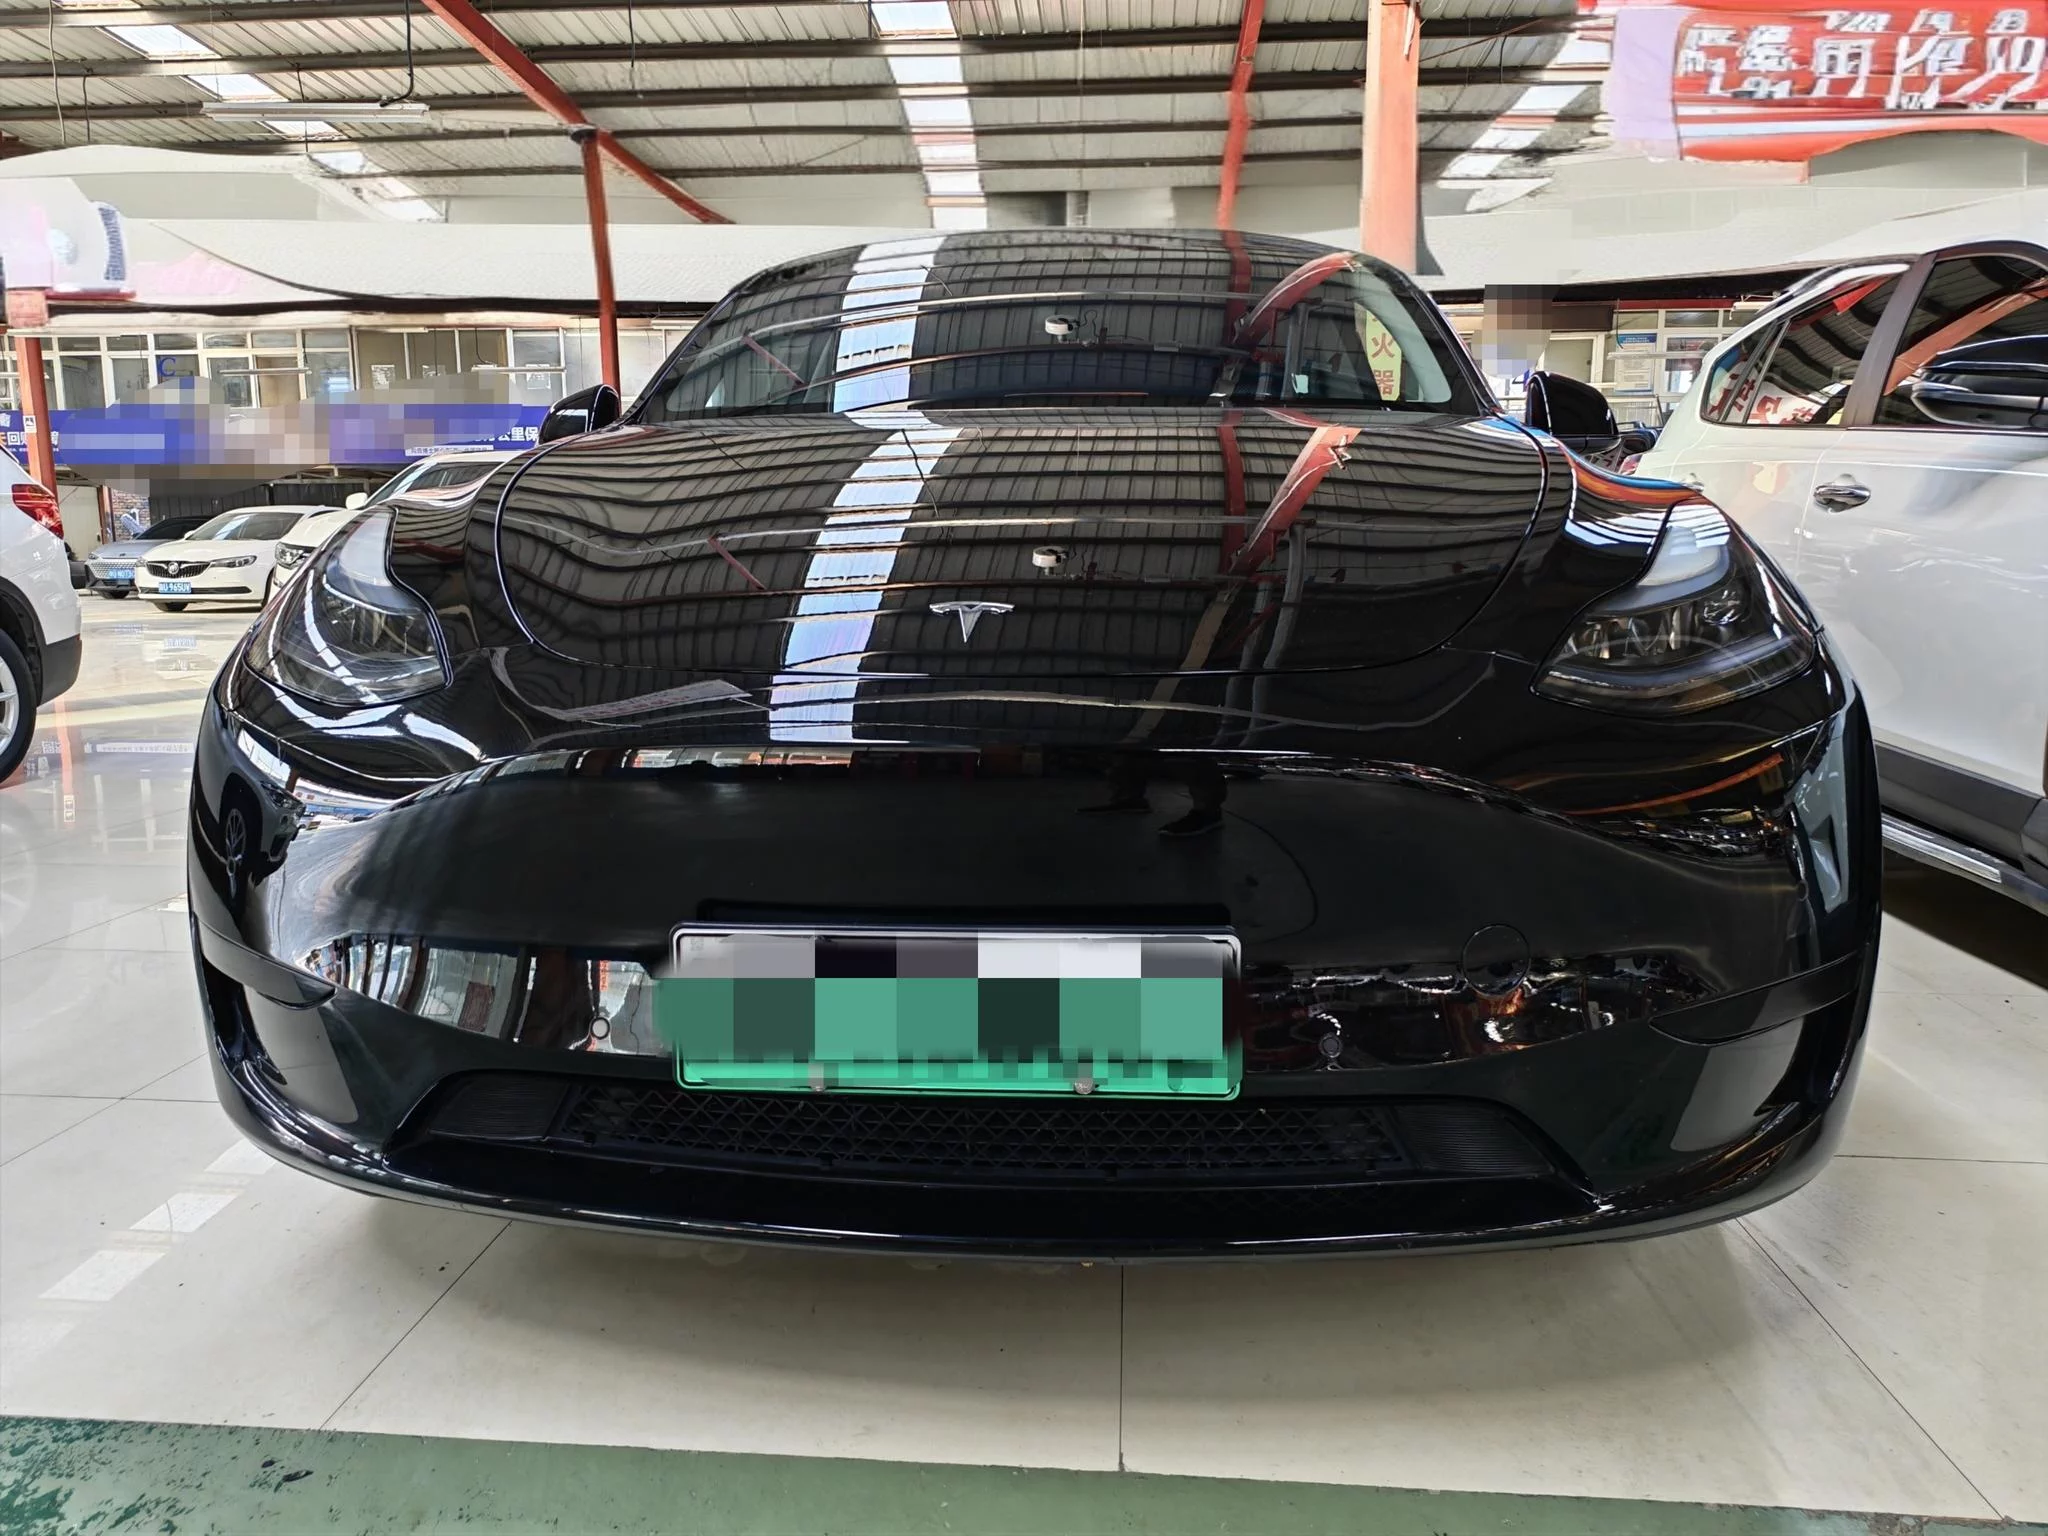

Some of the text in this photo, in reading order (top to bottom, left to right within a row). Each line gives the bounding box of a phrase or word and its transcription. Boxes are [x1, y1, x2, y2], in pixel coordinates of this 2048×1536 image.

[1371, 317, 1395, 394] 火器
[489, 427, 538, 442] 公里保
